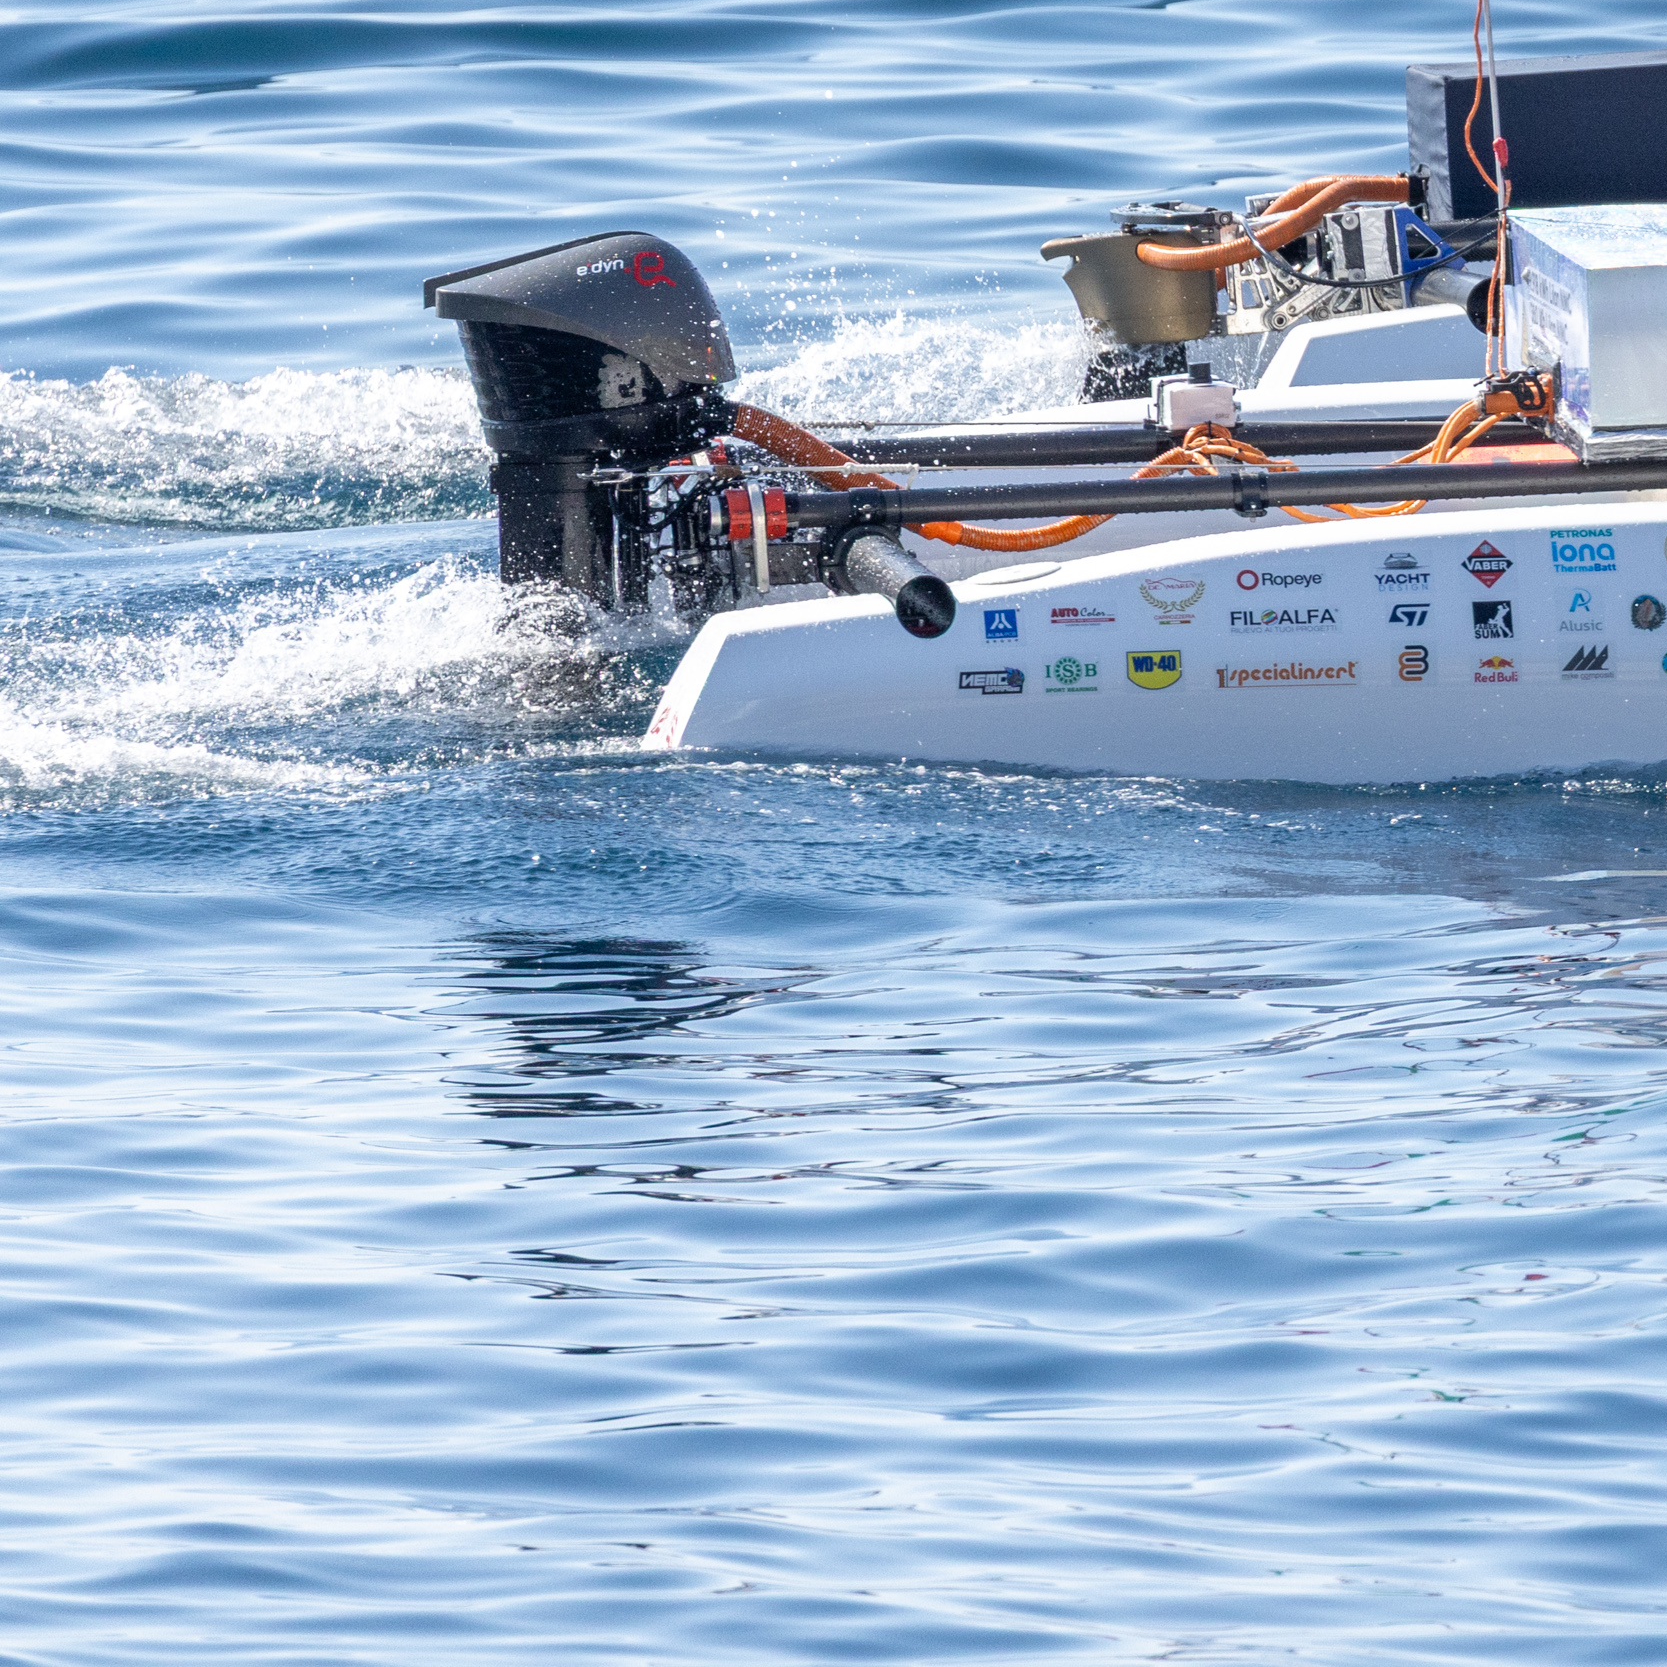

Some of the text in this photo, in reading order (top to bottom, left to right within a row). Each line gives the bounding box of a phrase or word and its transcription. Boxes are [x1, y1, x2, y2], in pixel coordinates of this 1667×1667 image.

[1550, 528, 1613, 538] PETRONAS
[1464, 557, 1509, 571] VABER
[1554, 563, 1617, 573] ThermaBatt
[1261, 572, 1322, 588] Ropeye
[1374, 573, 1431, 585] YACHT
[1378, 584, 1429, 593] DESIGN
[1051, 607, 1106, 618] AUTO Color
[1559, 620, 1603, 632] Alusic
[1474, 629, 1501, 640] SUM
[1132, 655, 1177, 672] WD-40
[1230, 661, 1357, 687] specialinsert
[1474, 672, 1496, 682] Red
